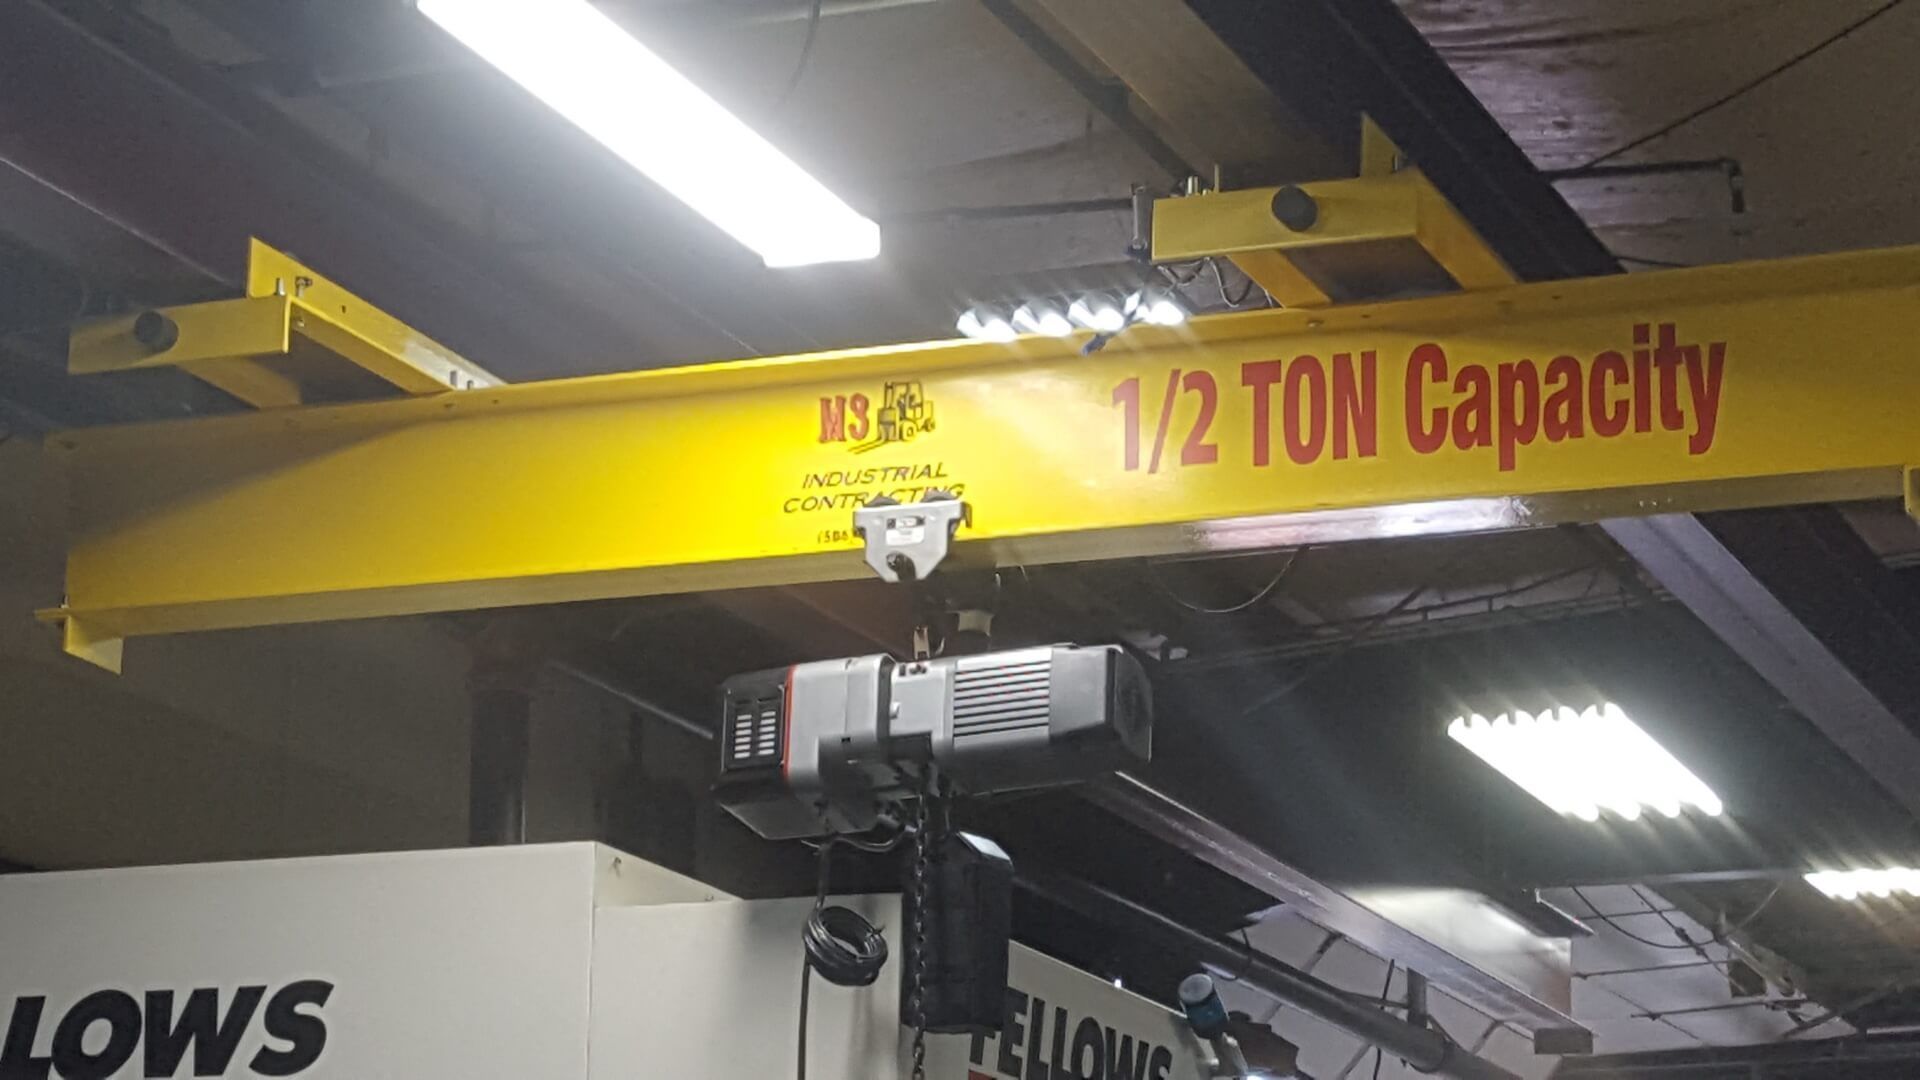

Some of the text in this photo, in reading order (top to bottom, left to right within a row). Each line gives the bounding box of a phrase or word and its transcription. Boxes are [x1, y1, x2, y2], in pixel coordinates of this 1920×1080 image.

[1112, 322, 1728, 474] 1/2 TON Capacity
[801, 462, 949, 489] INDUSTRIAL
[783, 484, 966, 513] CONTRCTG
